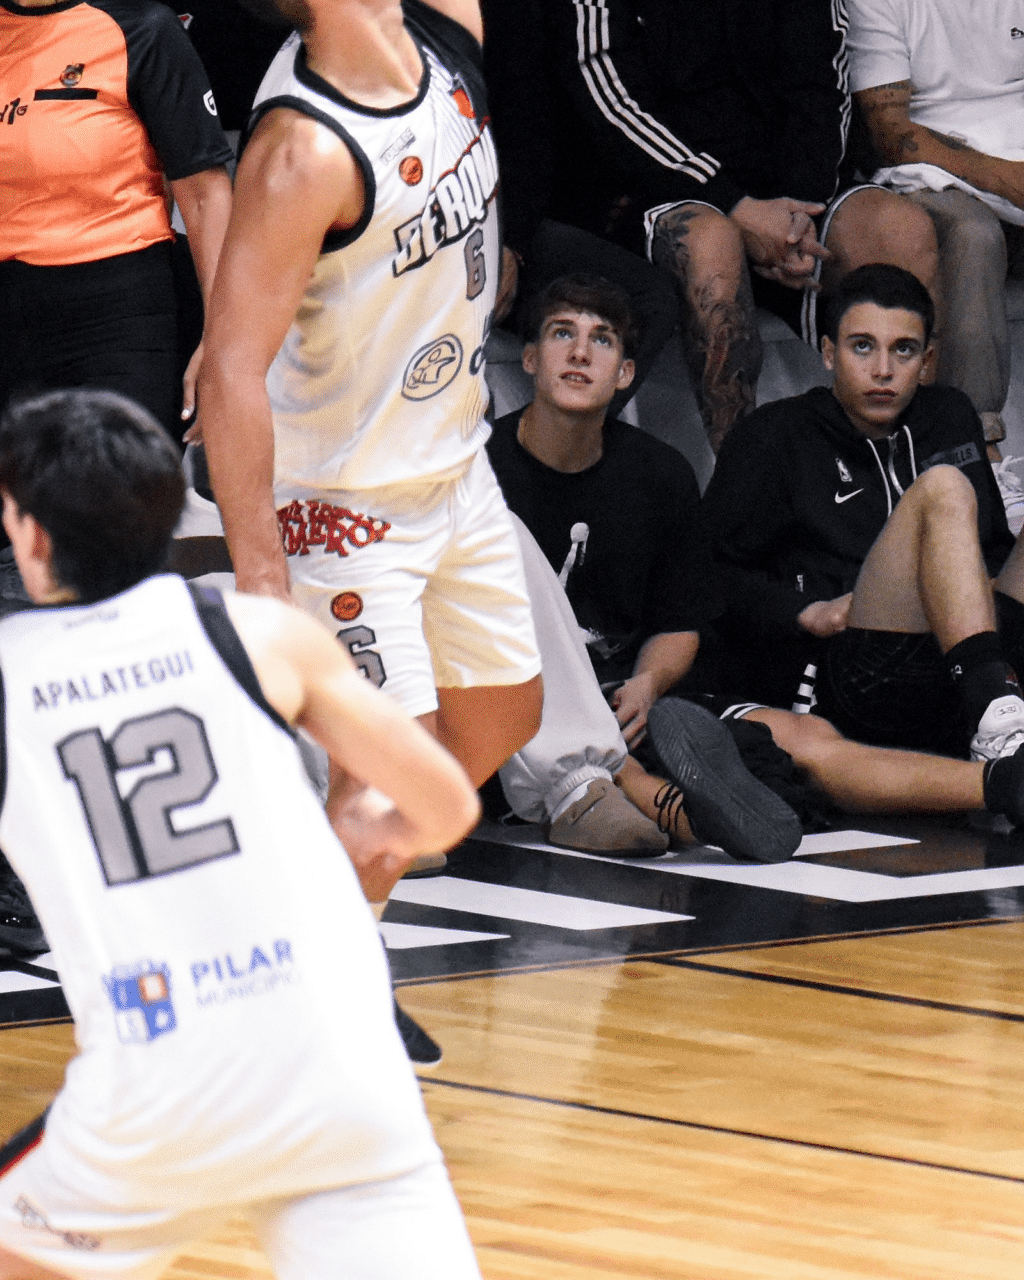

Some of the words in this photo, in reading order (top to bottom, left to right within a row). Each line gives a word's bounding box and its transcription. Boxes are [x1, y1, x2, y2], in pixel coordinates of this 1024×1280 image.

[464, 227, 487, 301] 6
[32, 649, 195, 712] APALATEGUI
[54, 704, 242, 889] 12
[189, 937, 294, 988] PILAR
